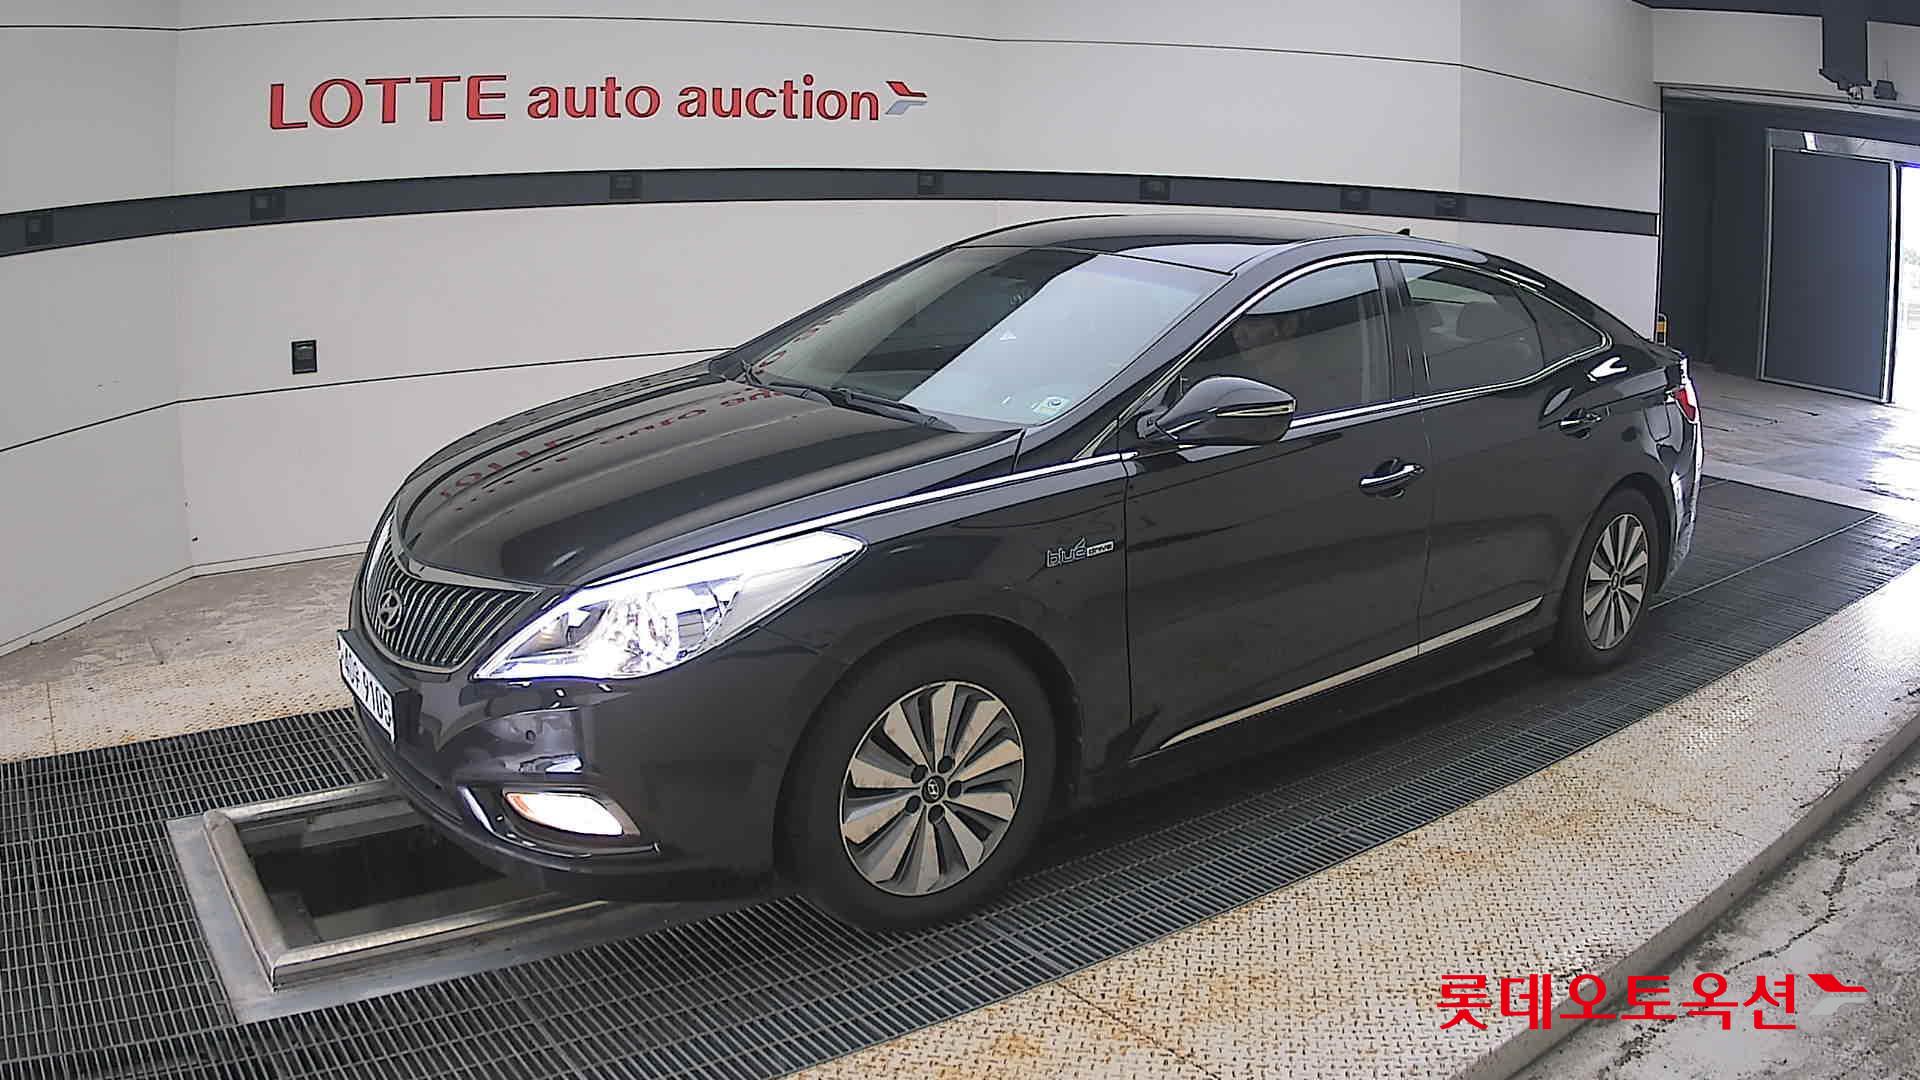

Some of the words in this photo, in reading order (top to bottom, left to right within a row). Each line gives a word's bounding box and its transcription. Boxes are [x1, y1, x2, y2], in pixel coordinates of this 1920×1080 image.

[269, 75, 507, 129] LOTTE
[527, 76, 662, 120] auto
[676, 74, 880, 121] auction
